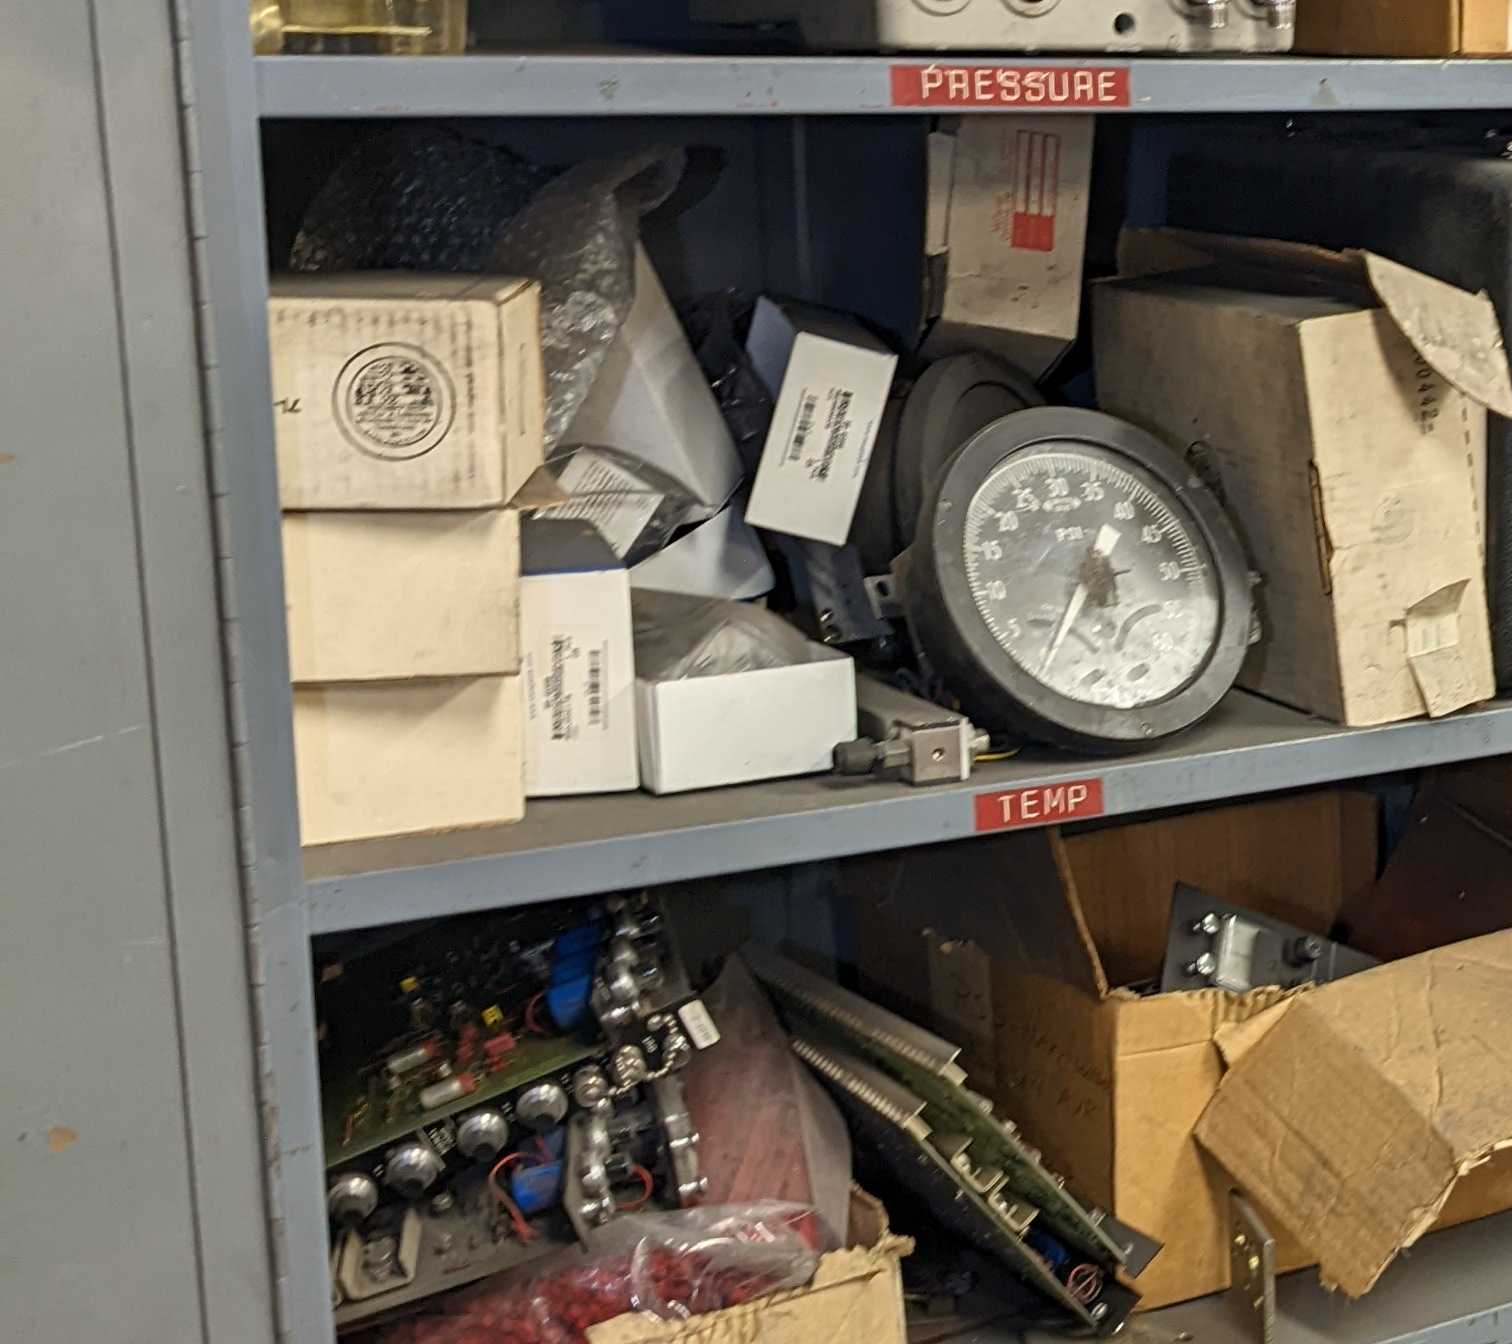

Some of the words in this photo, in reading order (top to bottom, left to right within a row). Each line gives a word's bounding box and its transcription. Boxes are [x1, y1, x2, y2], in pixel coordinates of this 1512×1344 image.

[920, 63, 1118, 103] PRESSURE
[1045, 477, 1070, 497] 30
[1080, 481, 1106, 502] 35
[1113, 501, 1136, 520] 40
[1141, 524, 1163, 544] 45
[981, 539, 1003, 560] 15
[1159, 561, 1181, 581] 50
[996, 784, 1089, 824] TEMP
